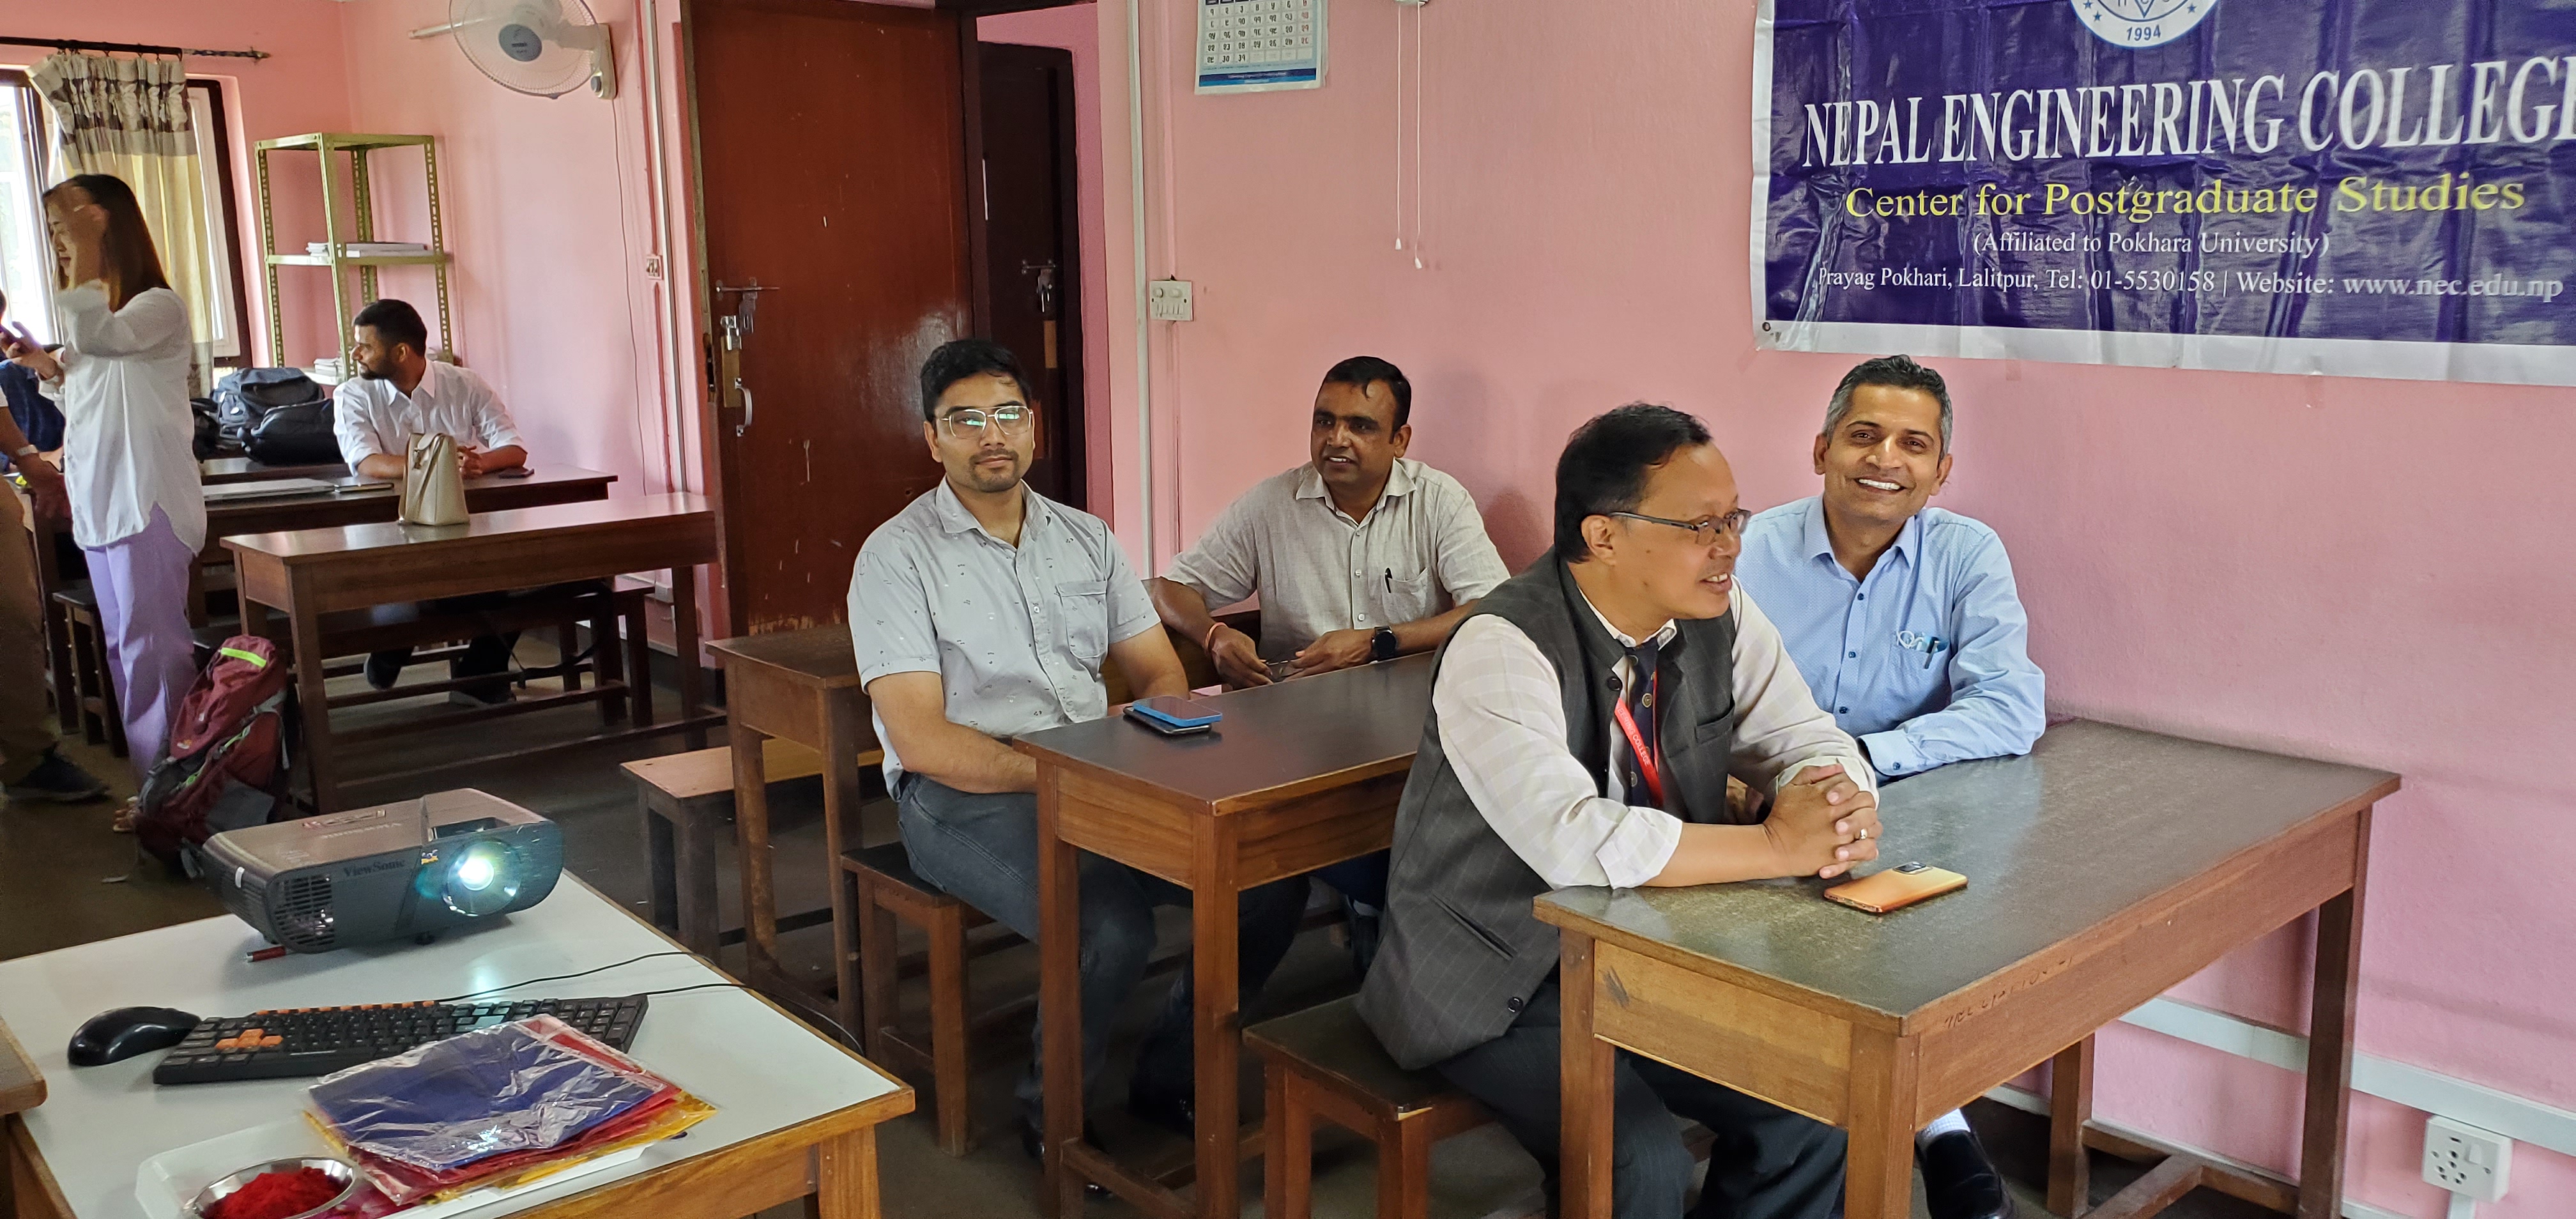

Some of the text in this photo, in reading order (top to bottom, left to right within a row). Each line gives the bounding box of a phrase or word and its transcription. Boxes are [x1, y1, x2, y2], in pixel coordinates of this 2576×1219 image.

[2126, 24, 2162, 41] 1994
[1802, 97, 1931, 167] NEPAL
[1938, 73, 2285, 162] ENGINEERING
[1846, 172, 2526, 223] Center for Postgraduate Studies
[1974, 232, 2329, 258] (Affiliated to Pokhara University)
[1819, 267, 1875, 290] Prayag
[1881, 267, 1952, 290] Pokhari,
[1958, 267, 2039, 292] Lalitpur,
[2046, 270, 2082, 289] Tel:
[2090, 271, 2215, 292] 01-5530158
[2237, 272, 2334, 295] Website:
[2342, 273, 2563, 303] www.nec.edu.np
[1632, 734, 1651, 767] COLLEGE
